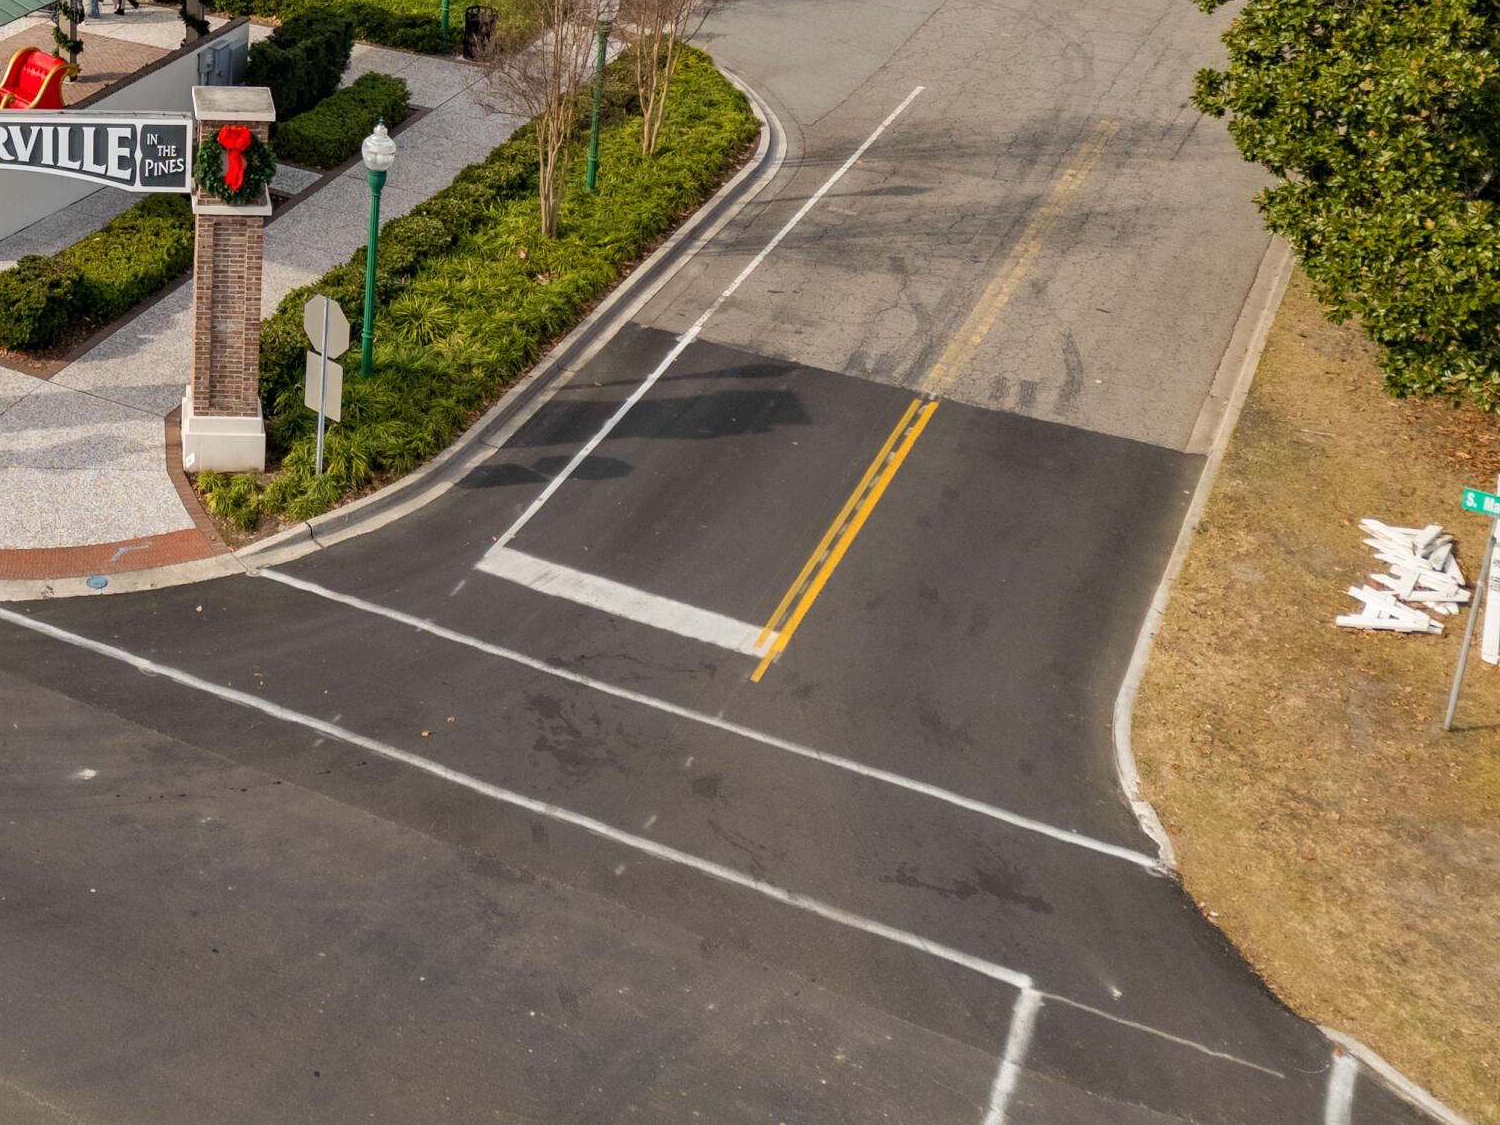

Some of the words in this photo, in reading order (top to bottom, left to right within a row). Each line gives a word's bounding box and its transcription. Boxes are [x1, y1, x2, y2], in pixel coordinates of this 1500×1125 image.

[146, 133, 158, 146] IN
[156, 145, 177, 158] THE
[144, 158, 185, 177] PINES
[1466, 491, 1478, 508] S.
